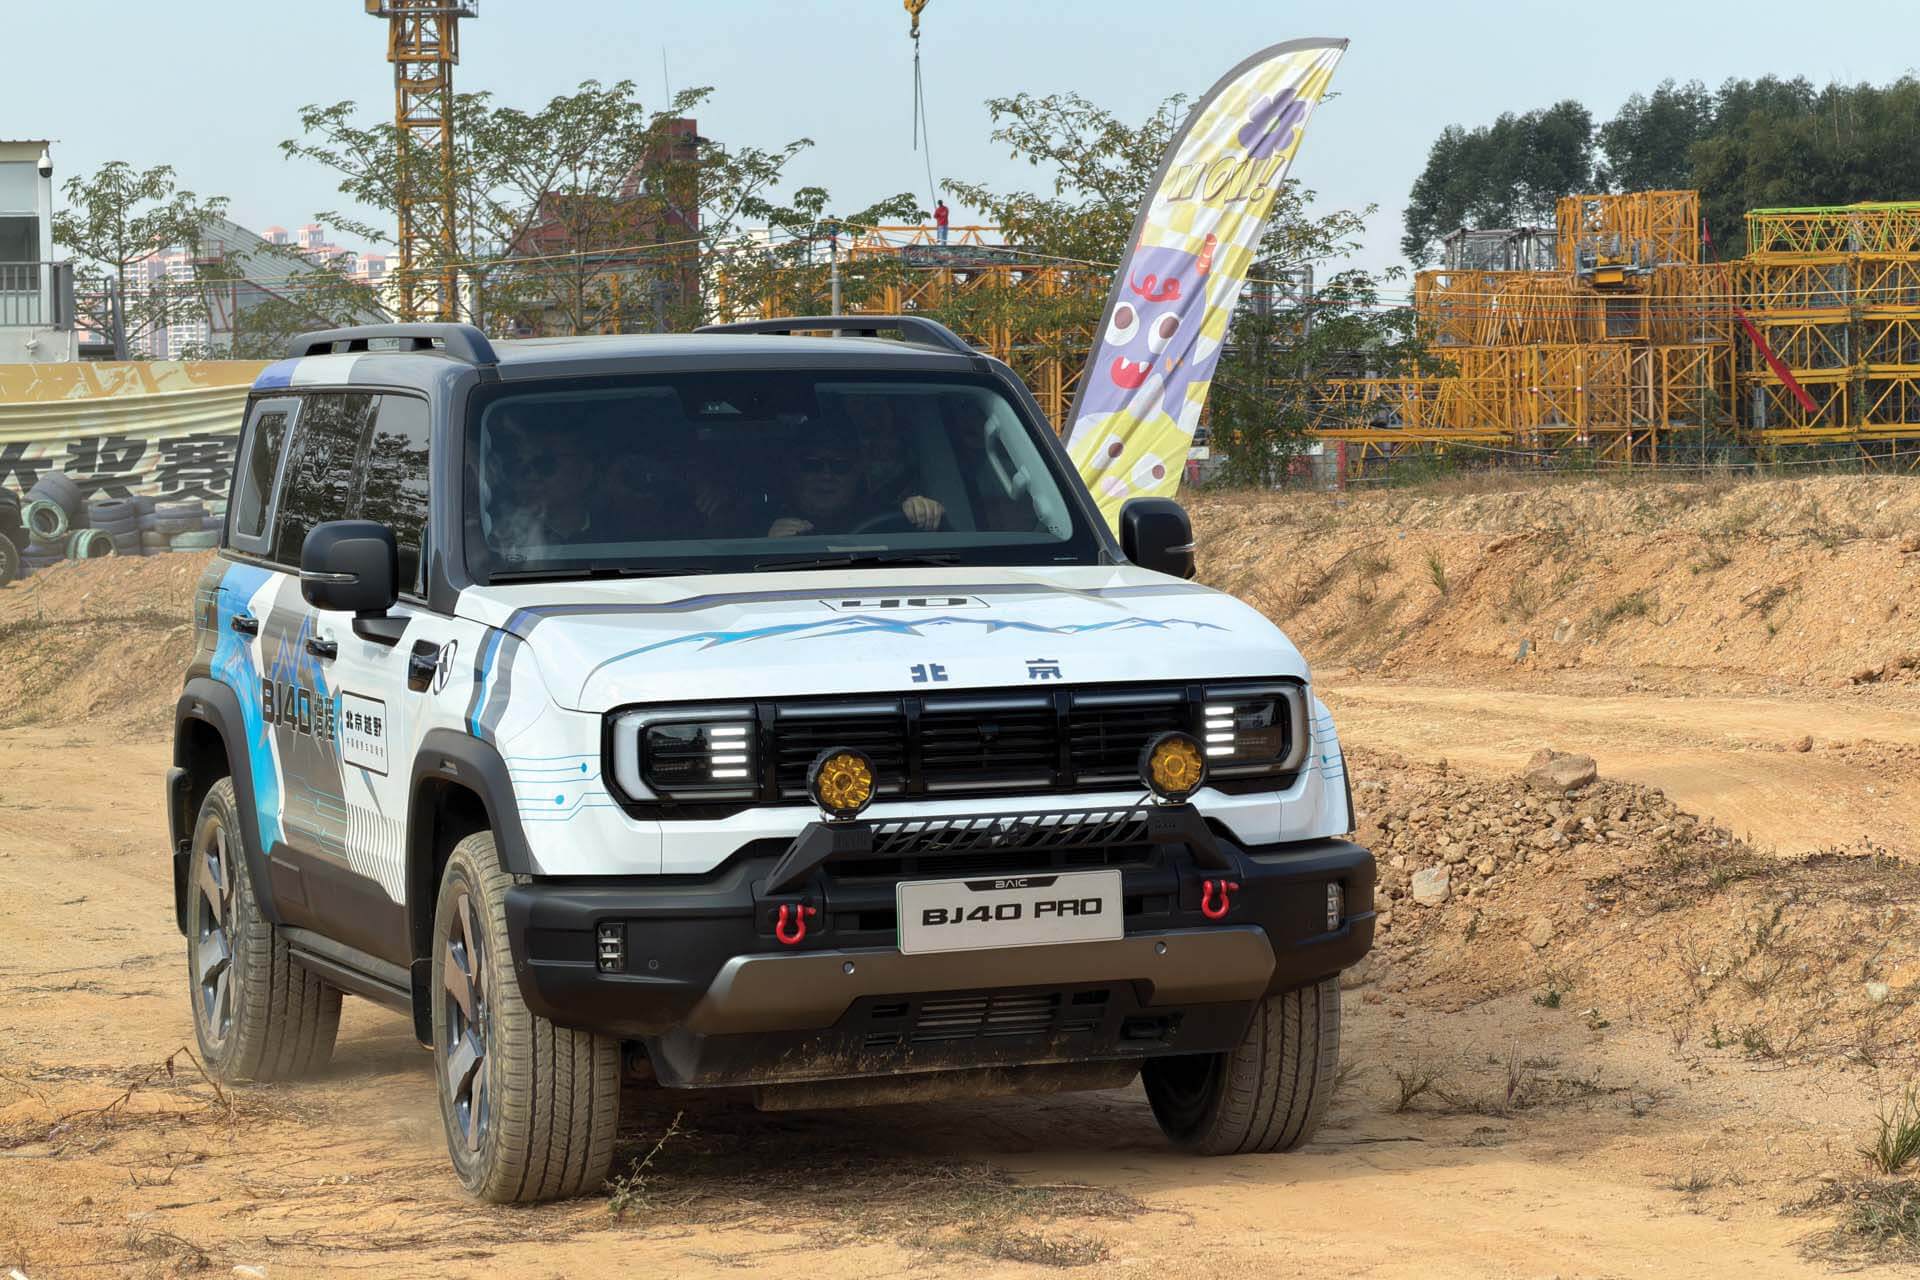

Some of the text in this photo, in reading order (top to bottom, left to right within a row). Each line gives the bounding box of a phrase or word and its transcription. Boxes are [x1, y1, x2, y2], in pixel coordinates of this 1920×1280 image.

[910, 658, 1063, 683] 北京
[345, 709, 382, 737] 北京越野
[995, 879, 1028, 889] BAIC
[922, 897, 1102, 926] BJ40 PRO
